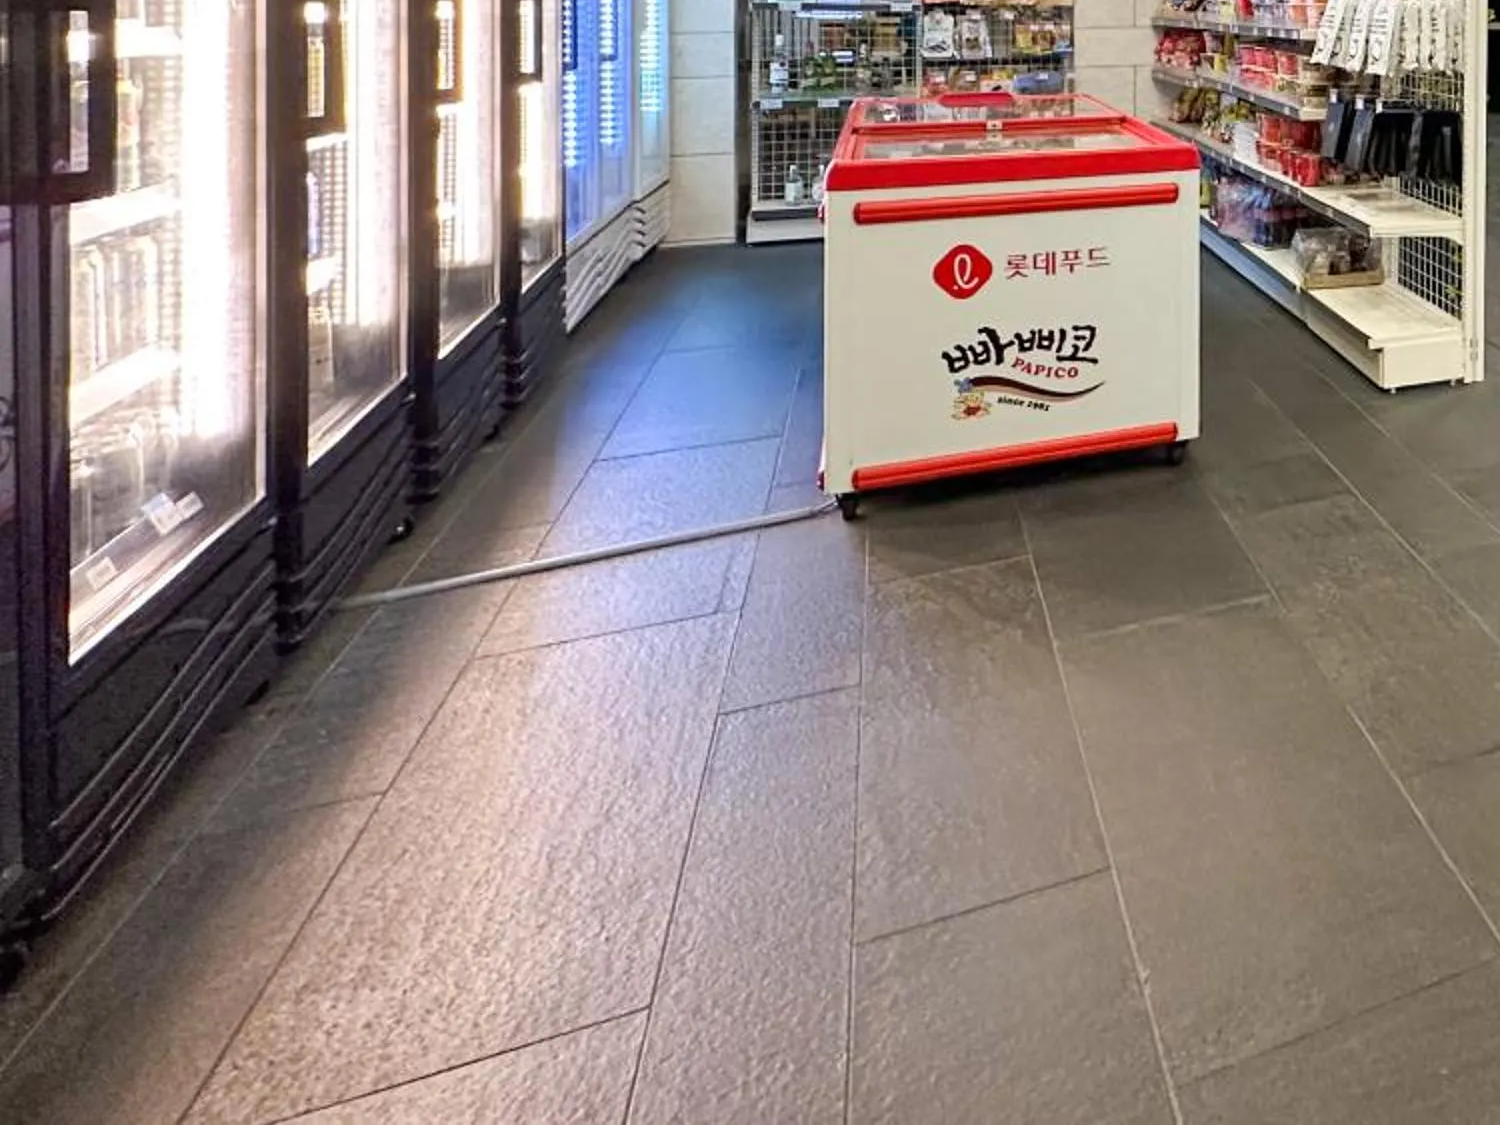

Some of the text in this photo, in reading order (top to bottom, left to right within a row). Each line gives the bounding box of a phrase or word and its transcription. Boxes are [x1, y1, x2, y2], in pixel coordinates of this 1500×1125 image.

[1004, 246, 1111, 280] 롯데푸드
[941, 325, 1099, 374] 빠삐코
[1010, 356, 1079, 379] PAPICO
